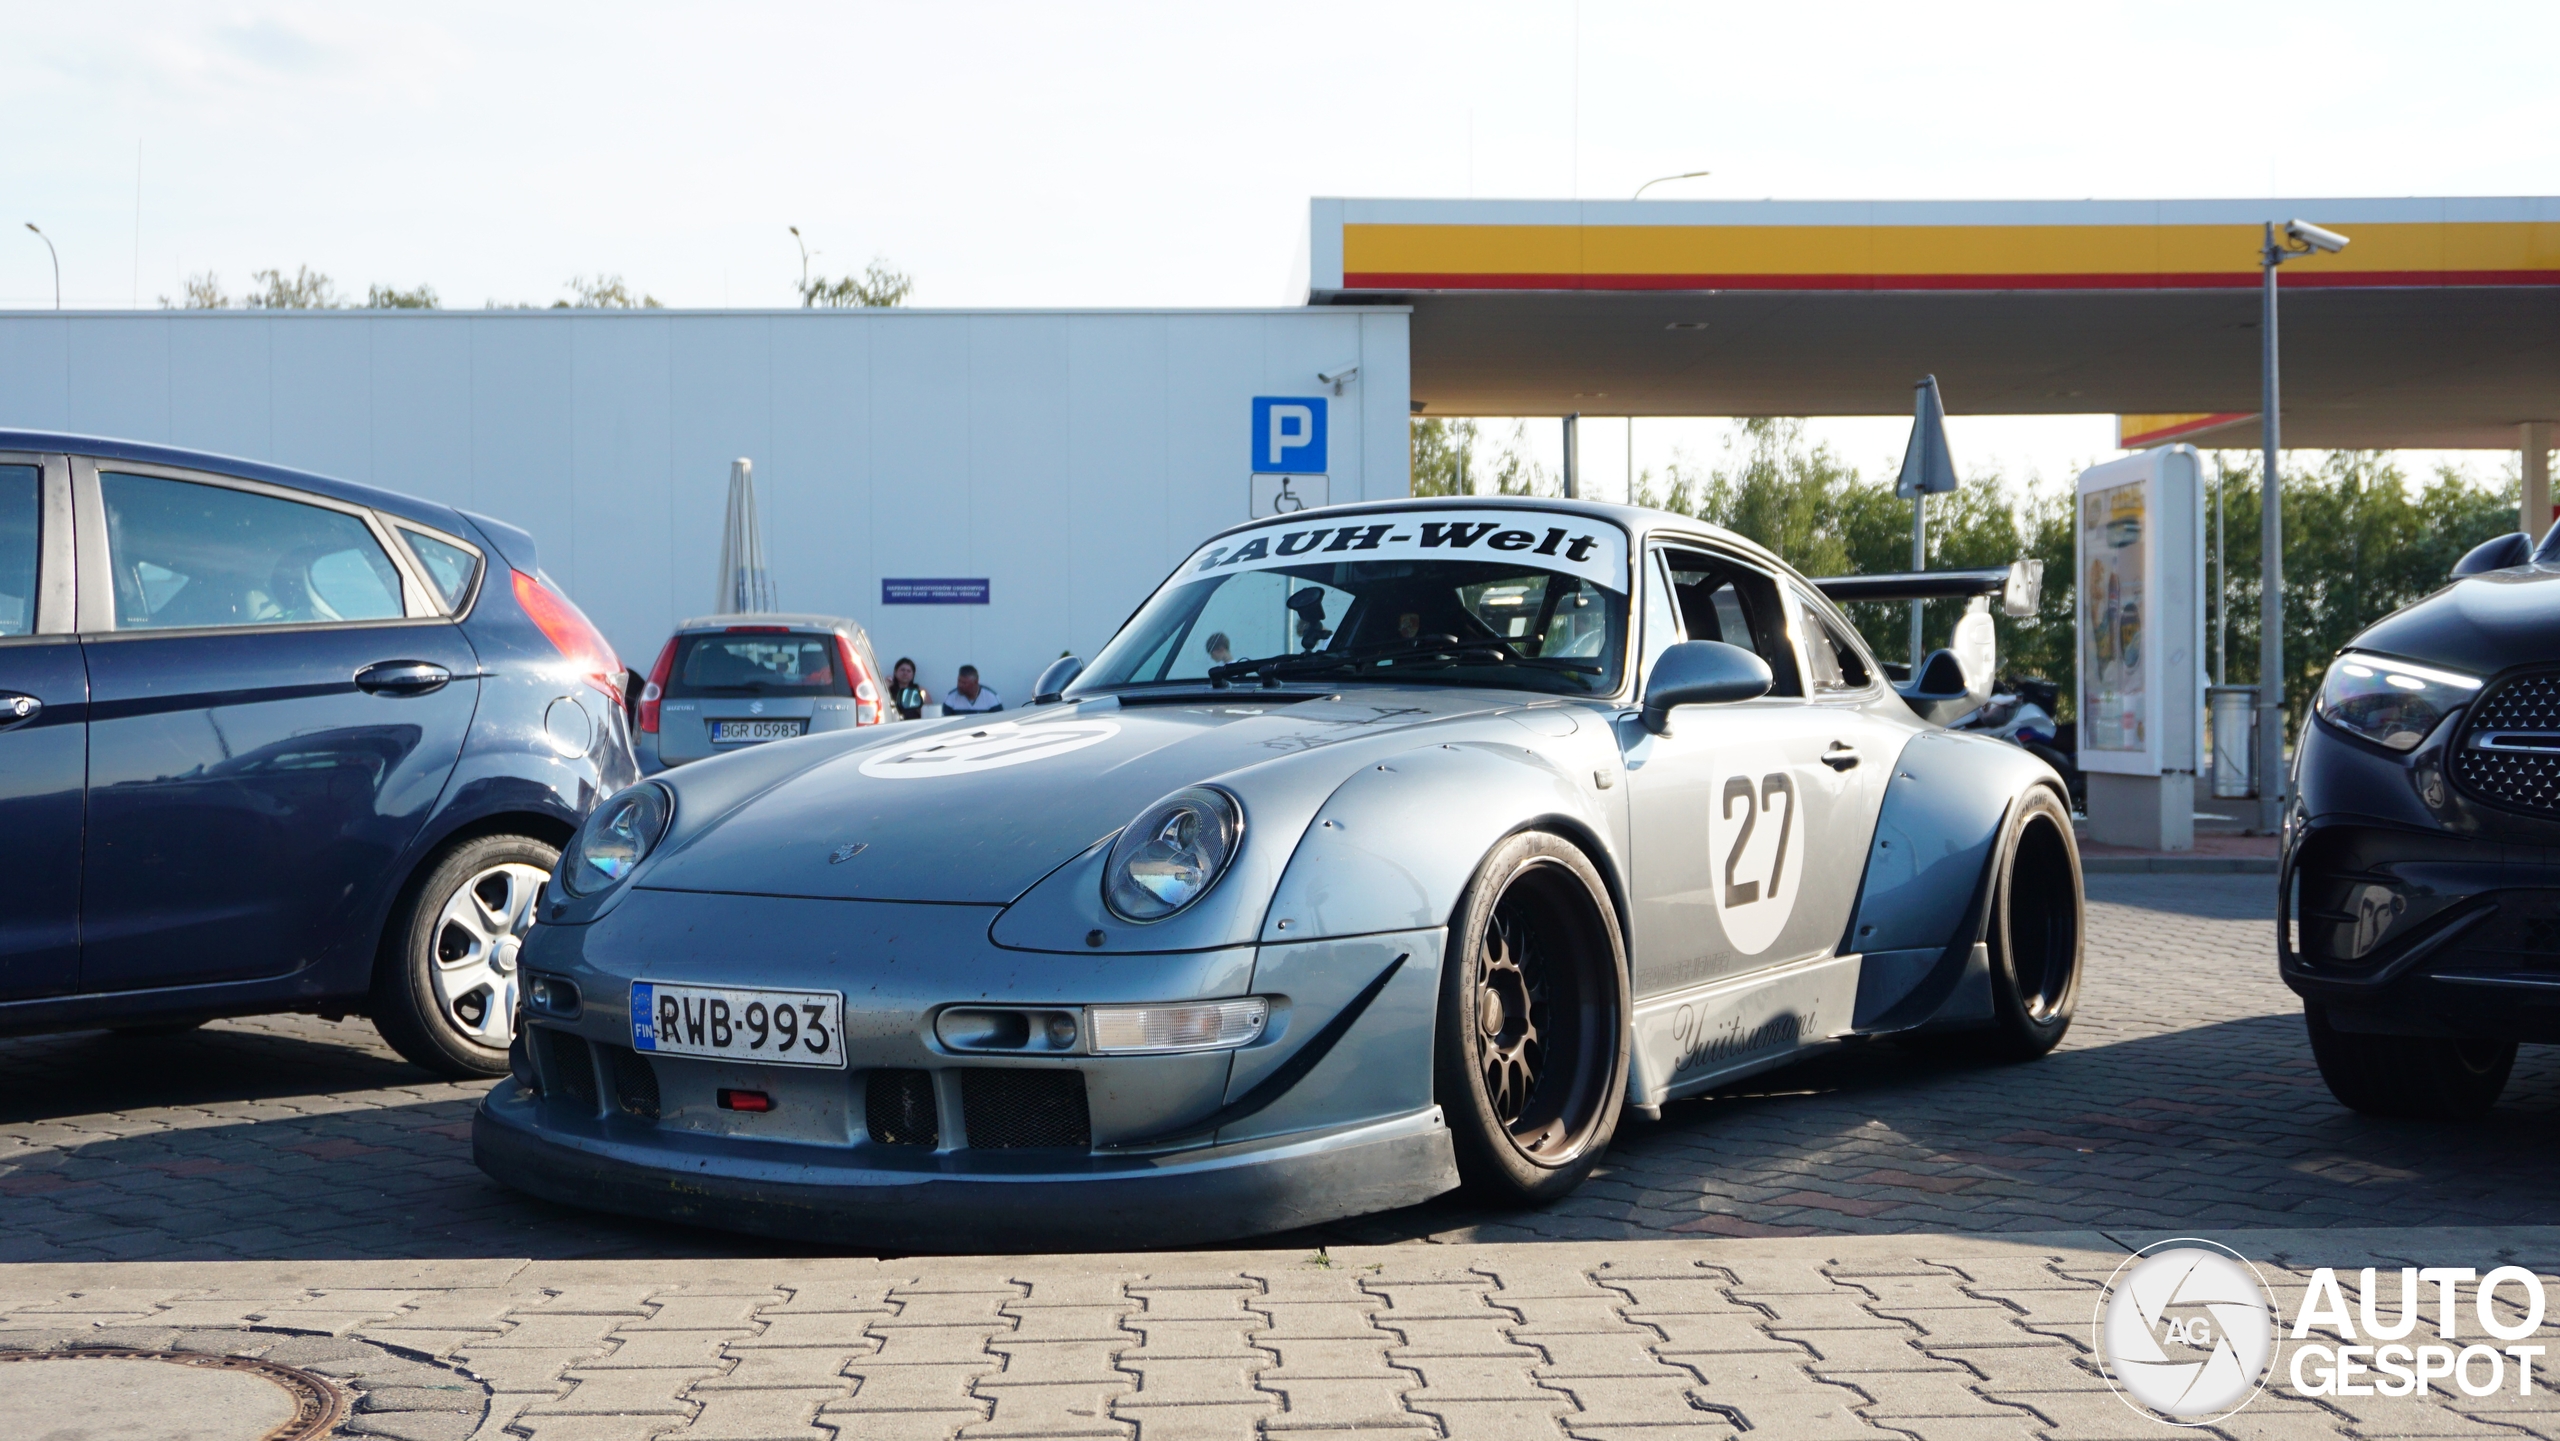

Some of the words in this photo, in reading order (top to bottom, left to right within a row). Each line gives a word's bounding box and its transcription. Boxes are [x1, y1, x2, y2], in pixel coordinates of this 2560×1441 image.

[1269, 404, 1312, 463] P
[1183, 522, 1599, 577] RAUH-Welt
[722, 724, 749, 738] BGR
[754, 724, 798, 737] 05985
[1723, 771, 1795, 909] 27
[635, 1023, 653, 1039] FIN
[659, 995, 830, 1054] RWB-993
